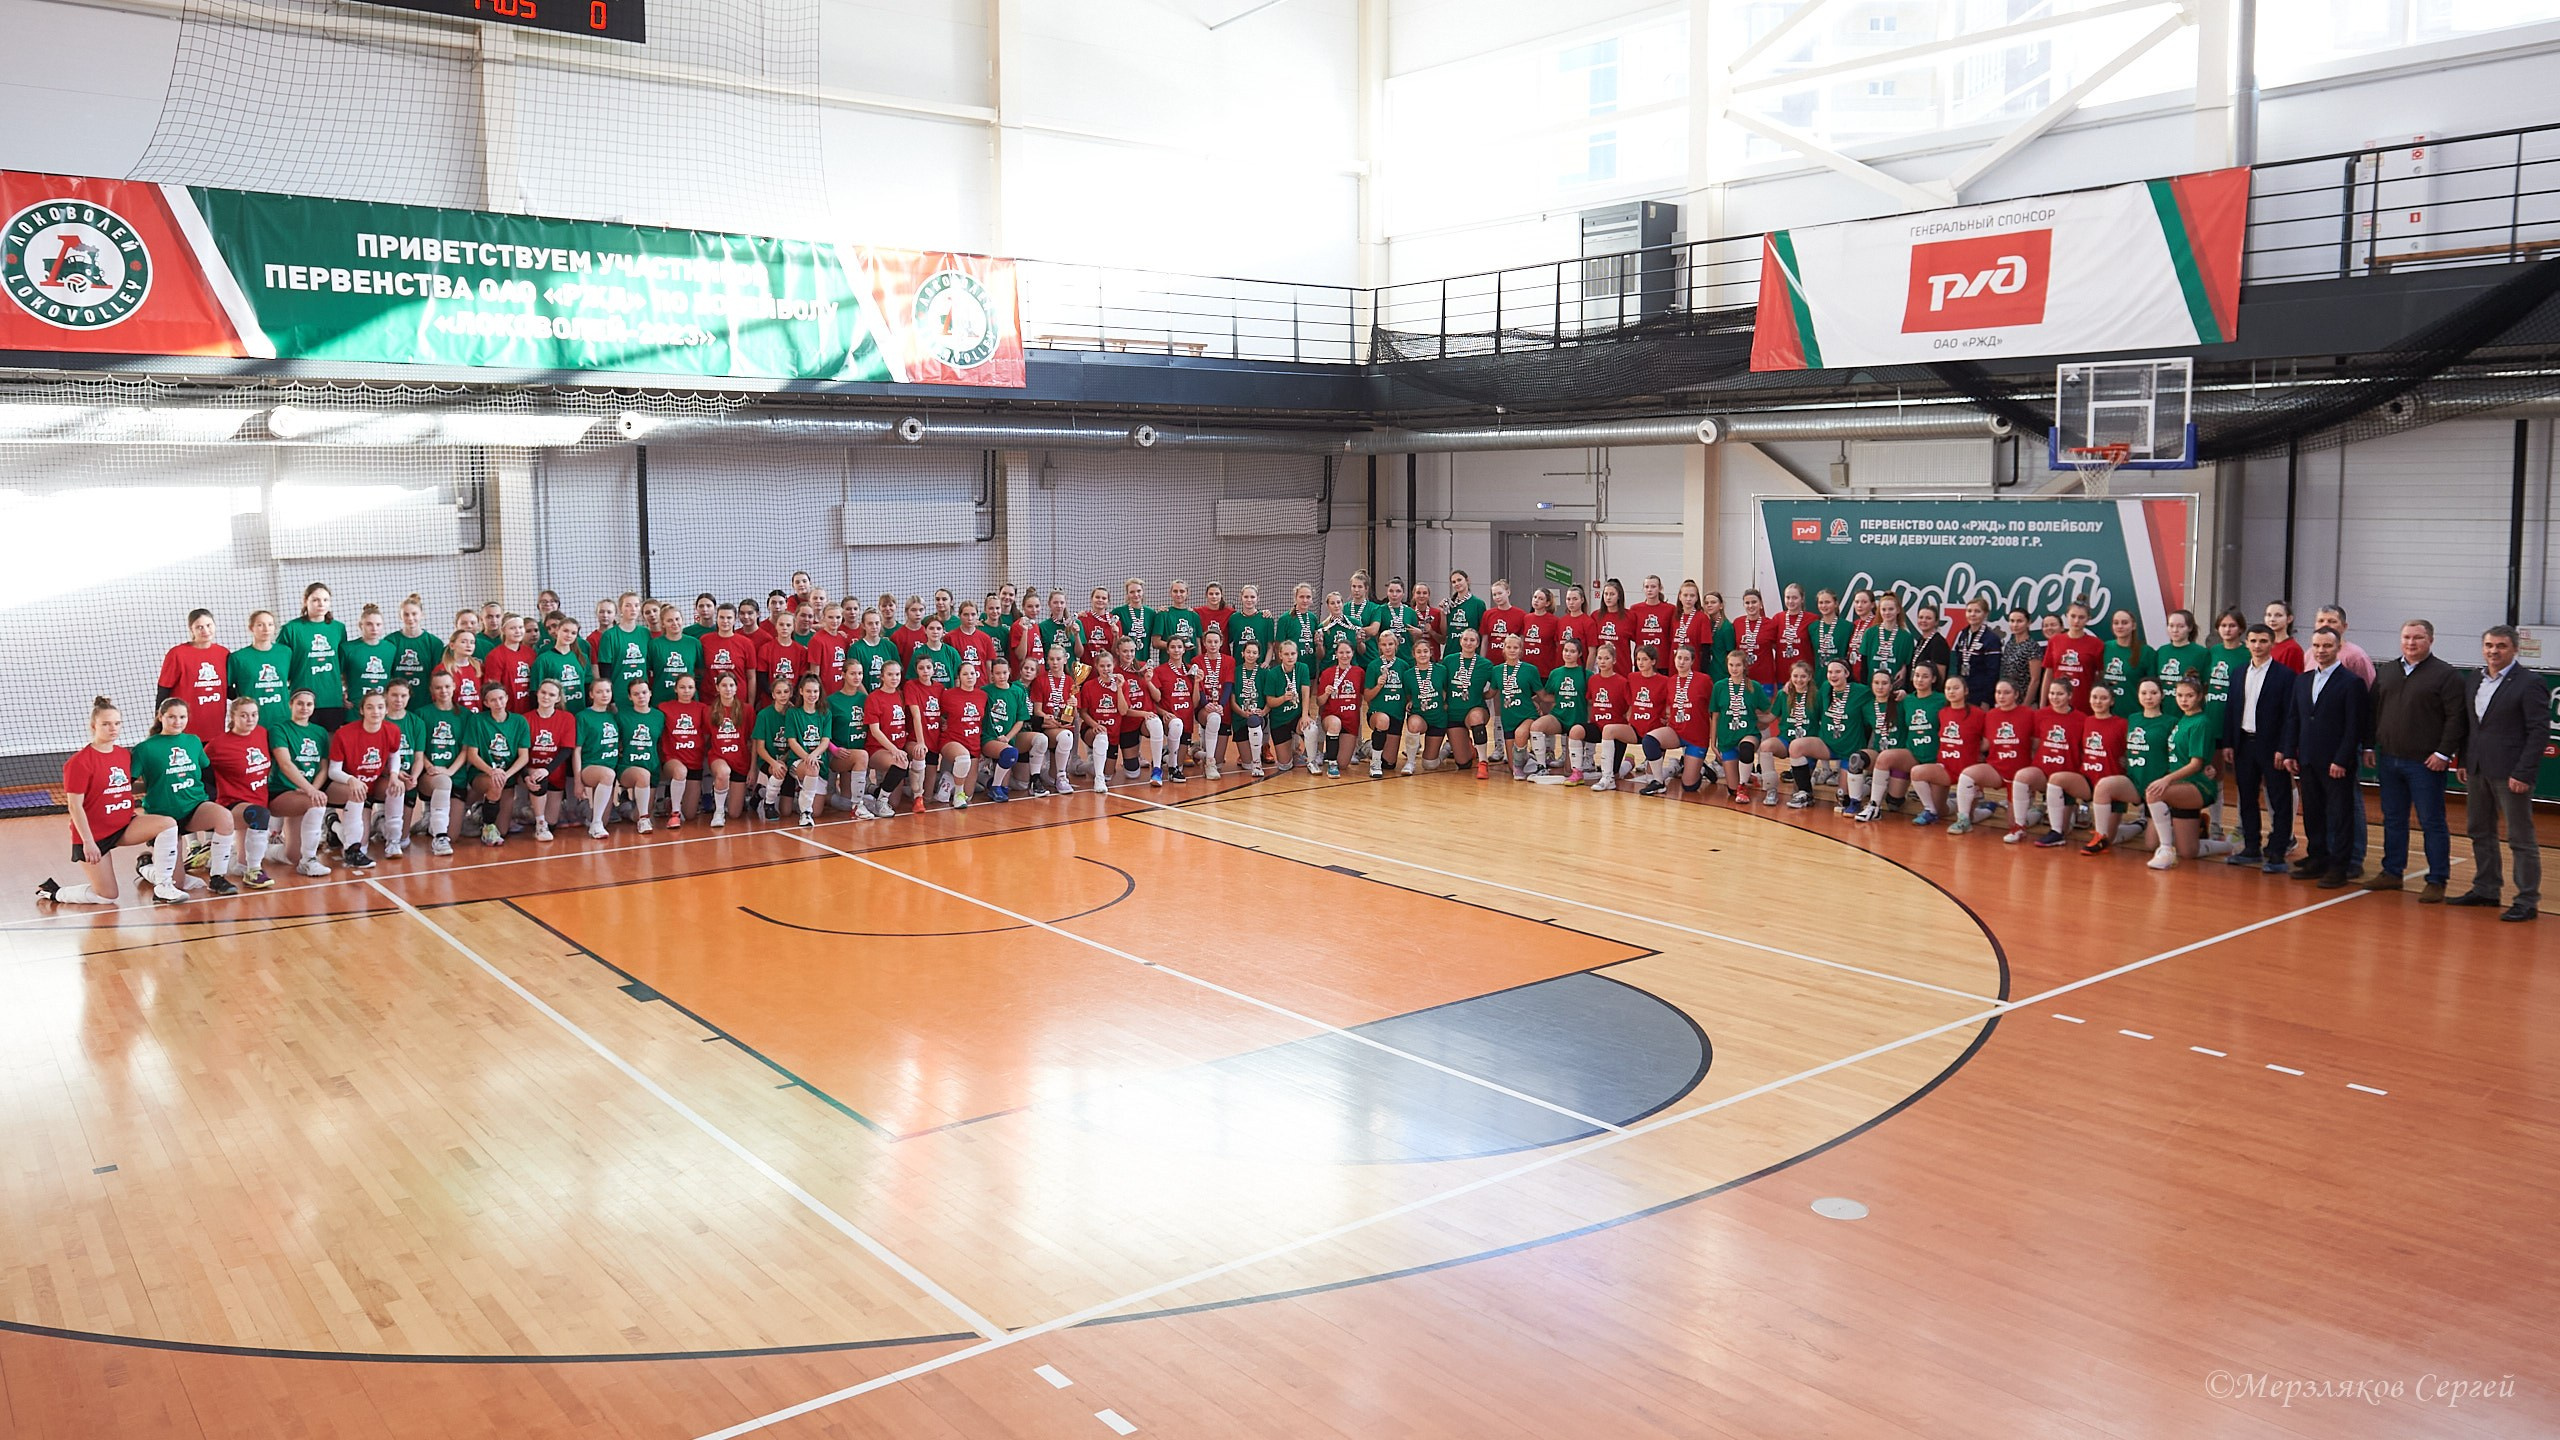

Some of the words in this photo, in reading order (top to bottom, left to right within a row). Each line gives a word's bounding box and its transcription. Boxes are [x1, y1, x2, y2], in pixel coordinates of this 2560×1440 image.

[590, 1, 607, 30] 0
[9, 206, 139, 252] ЛОКОВОЛЕЙ
[1910, 216, 1994, 237] ГЕНЕРАЛЬНЫЙ
[1998, 209, 2056, 227] СПОНСОР
[357, 233, 592, 273] ПРИВЕТСТВУЕМ
[8, 274, 141, 322] LOKOVOLLEY
[264, 264, 475, 300] ПЕРВЕНСТВА
[478, 278, 537, 303] ОАО
[1934, 338, 1958, 349] ОАО
[1962, 336, 2003, 348] «РЖД»
[1860, 519, 1932, 531] ПЕРВЕНСТВО
[1936, 520, 1959, 531] ОАО
[1961, 520, 2006, 532] «РЖД»
[2009, 521, 2026, 532] ПО
[2028, 518, 2103, 533] ВОЛЕЙБОЛУ
[1860, 533, 1898, 546] СРЕДИ
[1899, 534, 1957, 547] ДЕВУШЕК
[1959, 535, 2020, 546] 2007-2008
[2022, 536, 2043, 547] Г.Р.
